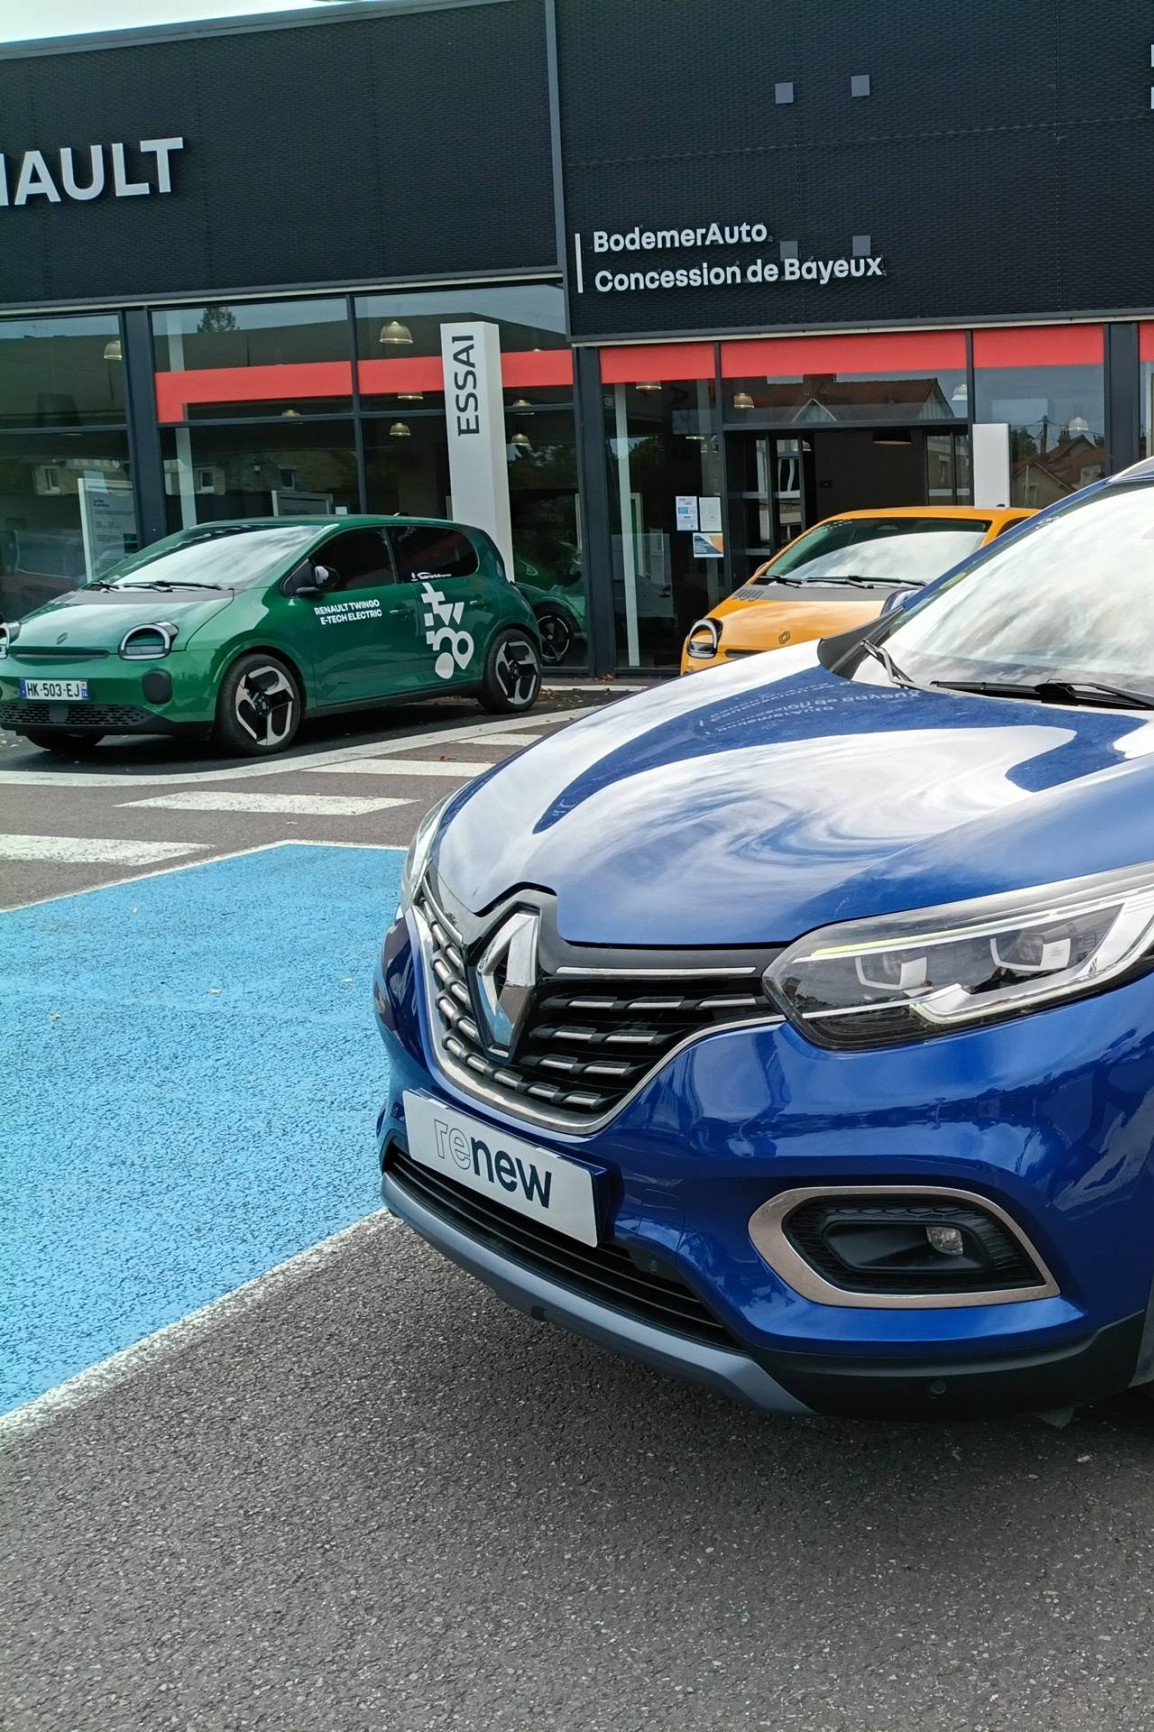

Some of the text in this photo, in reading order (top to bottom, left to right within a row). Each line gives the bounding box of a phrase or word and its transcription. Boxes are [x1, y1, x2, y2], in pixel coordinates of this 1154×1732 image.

[593, 222, 768, 253] BodemerAuto
[595, 257, 883, 293] Concession de Bayeux
[452, 335, 480, 437] ESSAI
[314, 599, 380, 615] RENAULT TWINGO
[320, 609, 382, 625] E-TECH ELECTRIC
[27, 683, 80, 697] HK-503-EJ
[434, 1119, 552, 1209] renew
